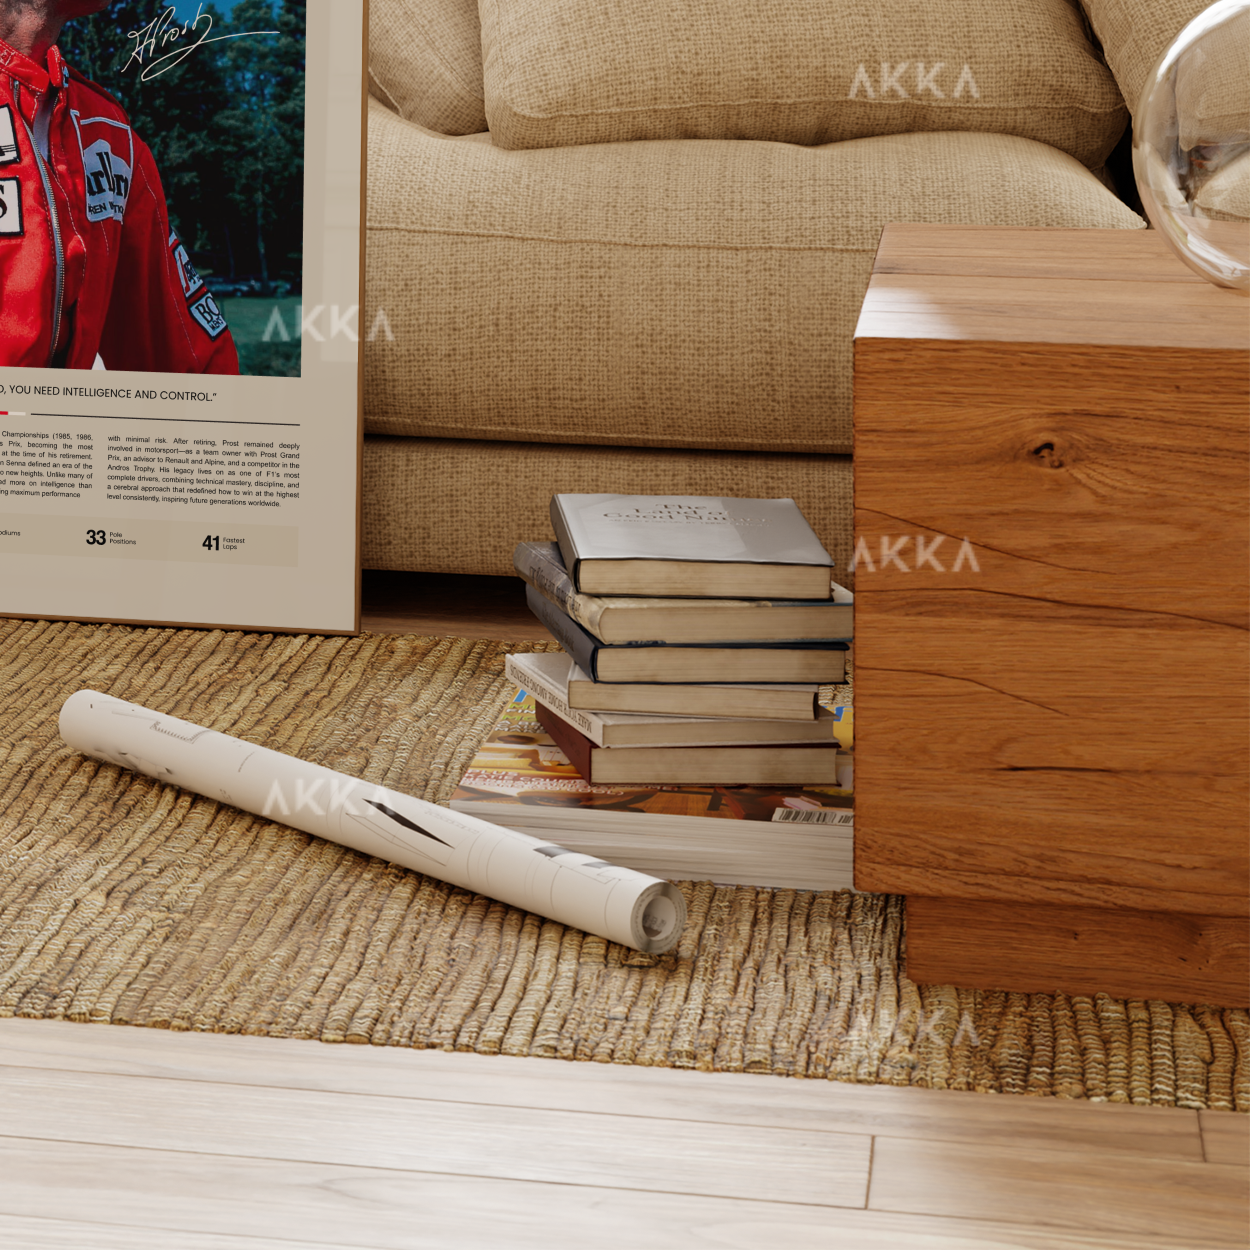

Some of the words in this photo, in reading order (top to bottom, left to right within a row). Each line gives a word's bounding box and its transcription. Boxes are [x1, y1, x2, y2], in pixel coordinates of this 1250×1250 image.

[9, 385, 30, 394] YOU
[34, 386, 60, 395] NEED
[62, 387, 131, 398] INTELLIGENCE
[134, 390, 157, 399] AND
[160, 390, 216, 401] CONTROL.”
[86, 529, 106, 545] 33
[202, 535, 220, 551] 41
